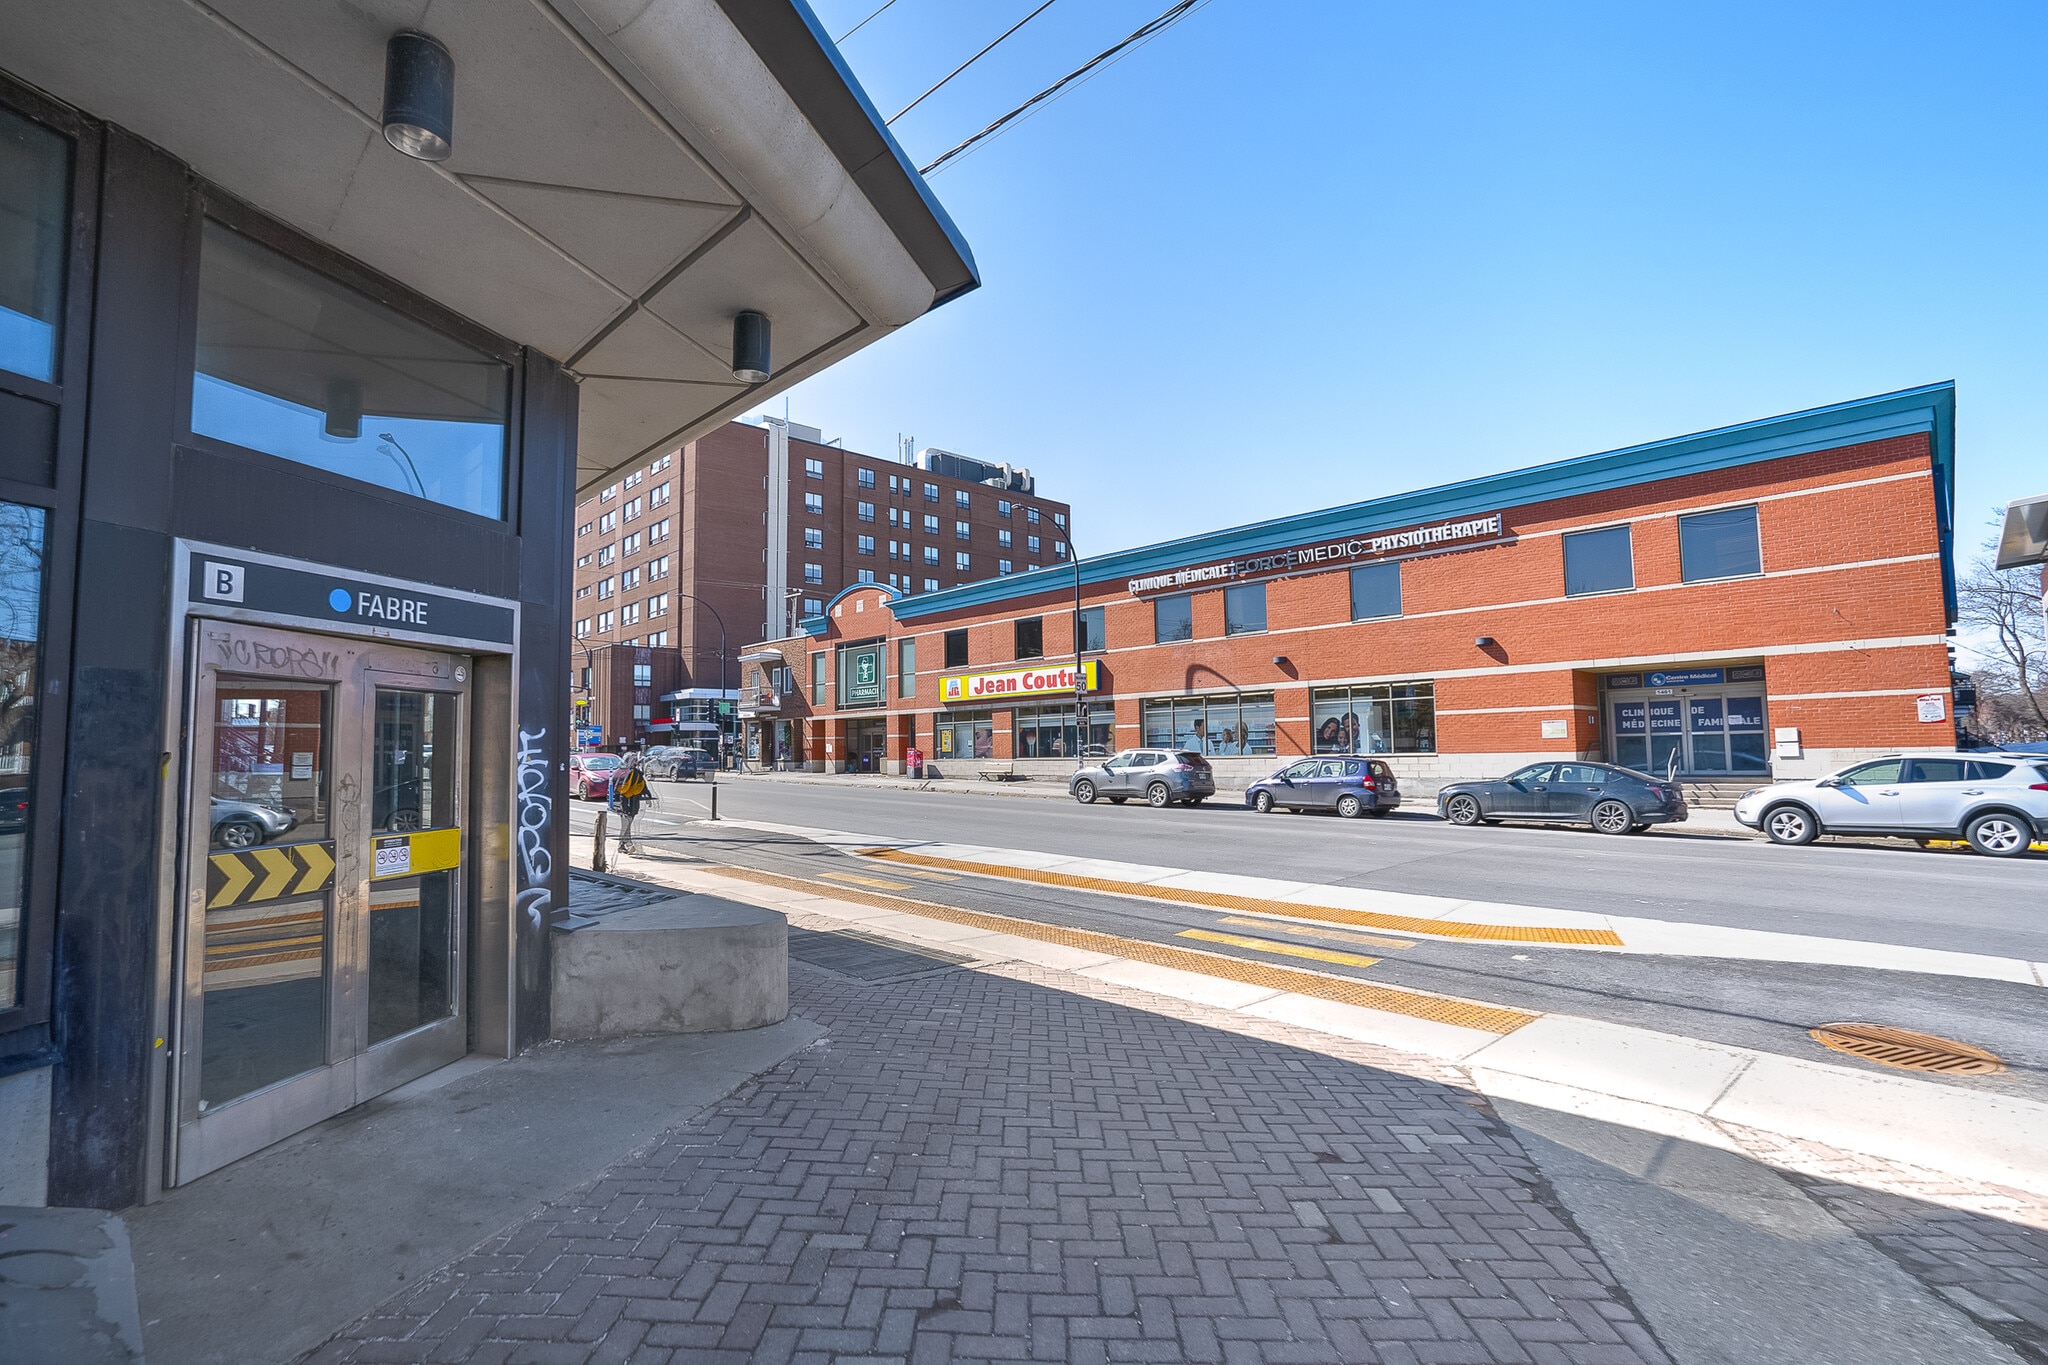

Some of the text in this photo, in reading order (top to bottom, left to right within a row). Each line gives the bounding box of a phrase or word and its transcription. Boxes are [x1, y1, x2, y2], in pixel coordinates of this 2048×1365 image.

[1128, 574, 1176, 594] CLINIQUE
[1176, 564, 1229, 585] MÉDICALE
[1371, 516, 1499, 552] PHYSIOTHÉRAPIE
[216, 569, 234, 596] B
[357, 591, 428, 625] FABRE
[974, 677, 1017, 695] Jean
[1076, 682, 1087, 691] 50
[1691, 706, 1704, 714] DE
